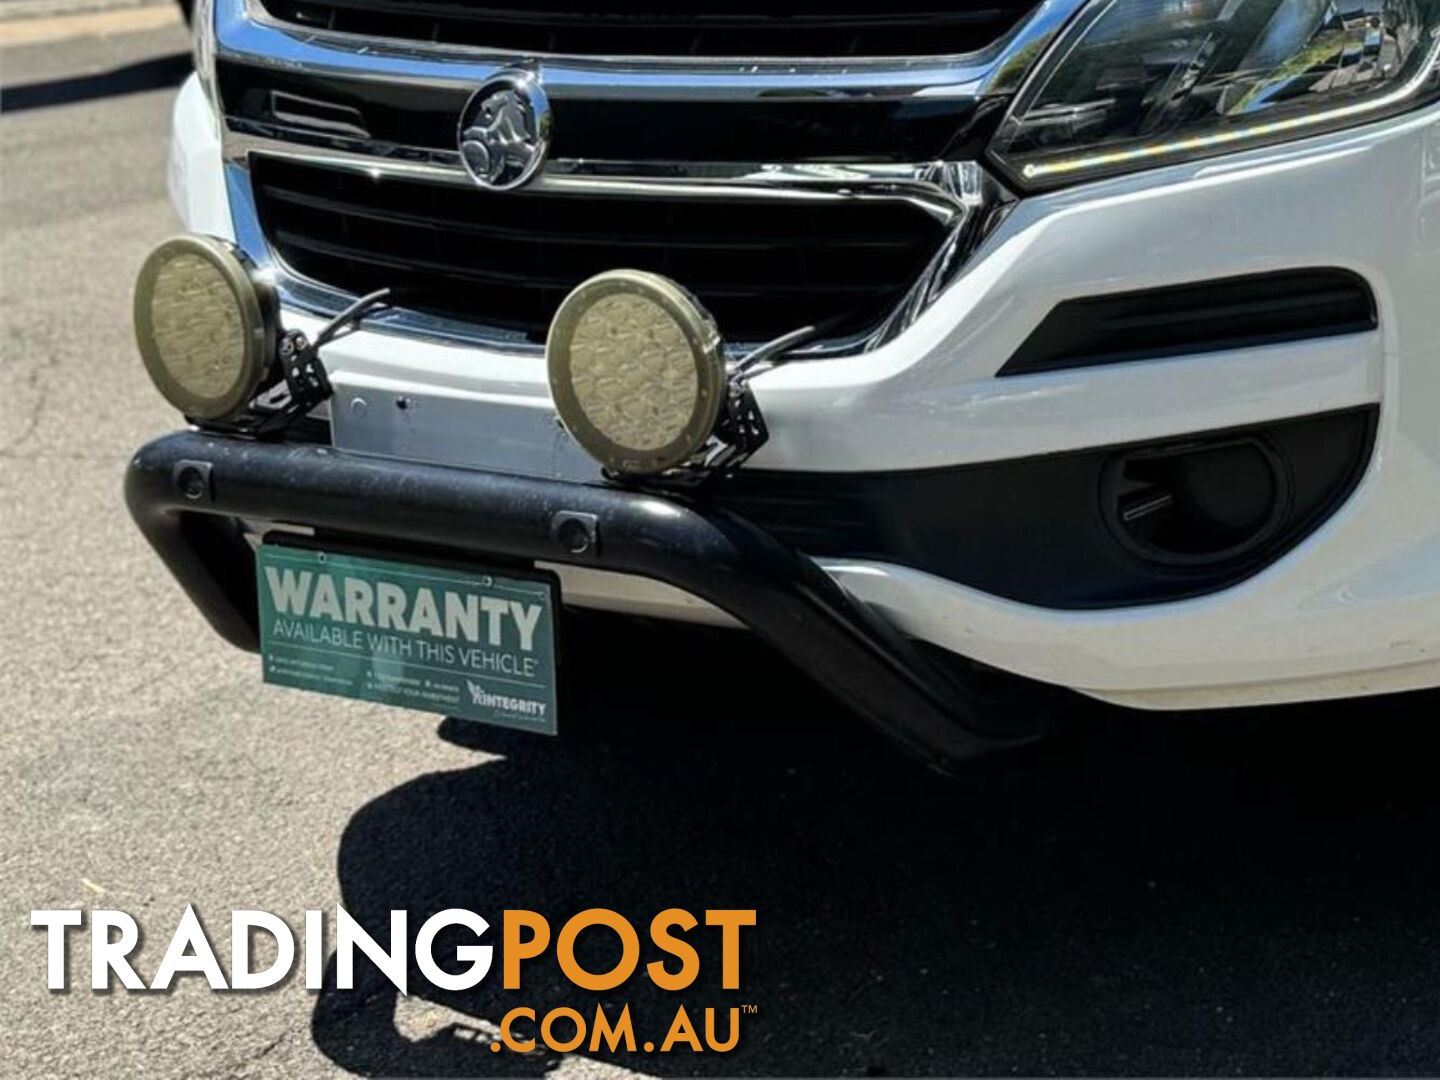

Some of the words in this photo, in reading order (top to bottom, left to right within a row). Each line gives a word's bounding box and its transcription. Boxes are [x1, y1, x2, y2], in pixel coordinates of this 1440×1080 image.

[265, 566, 543, 651] WARRANTY
[273, 620, 362, 649] AVAILABLE
[367, 633, 411, 656] WITH
[416, 640, 454, 664] THIS
[481, 693, 547, 716] INTEGRITY
